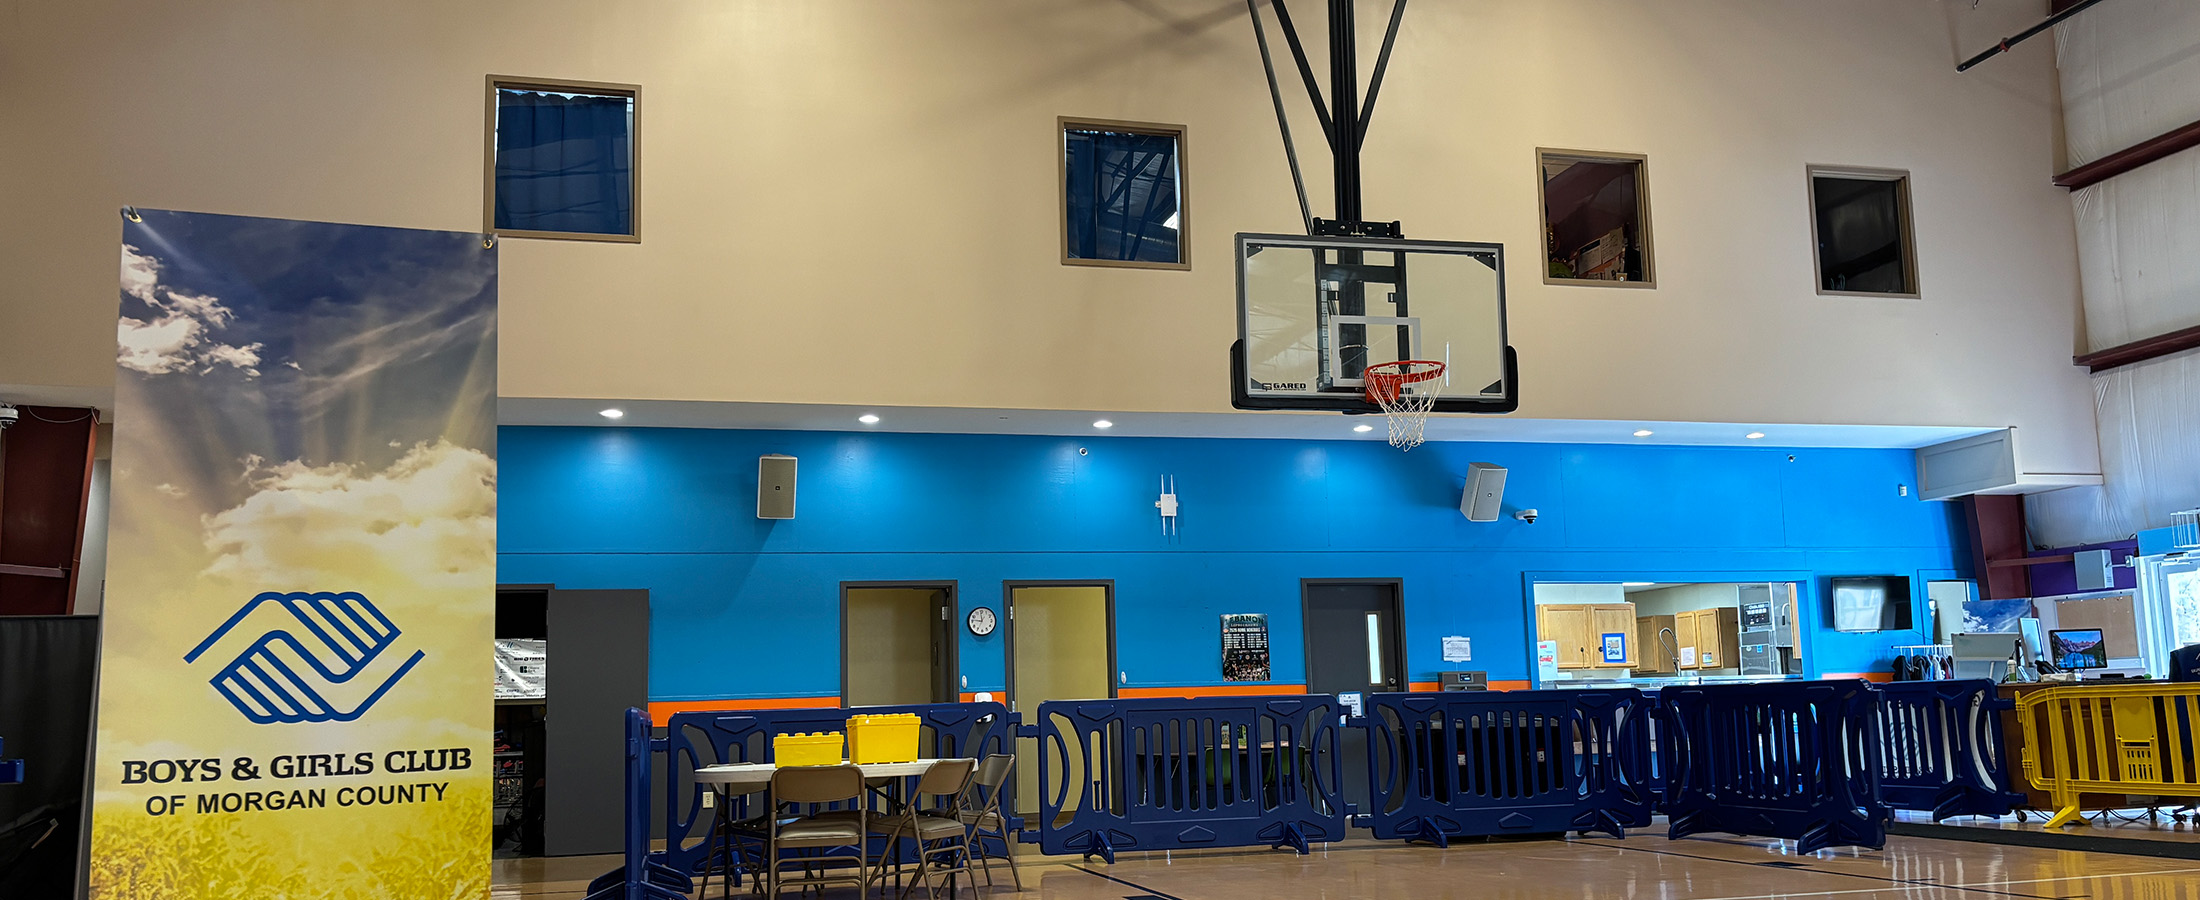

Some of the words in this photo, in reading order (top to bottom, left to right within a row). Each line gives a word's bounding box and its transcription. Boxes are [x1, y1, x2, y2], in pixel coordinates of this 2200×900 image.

[121, 758, 222, 785] BOYS
[231, 756, 262, 781] &
[270, 752, 375, 779] GIRLS
[384, 747, 472, 774] CLUB
[145, 794, 186, 816] OF
[196, 788, 326, 814] MORGAN
[336, 781, 450, 807] COUNTY
